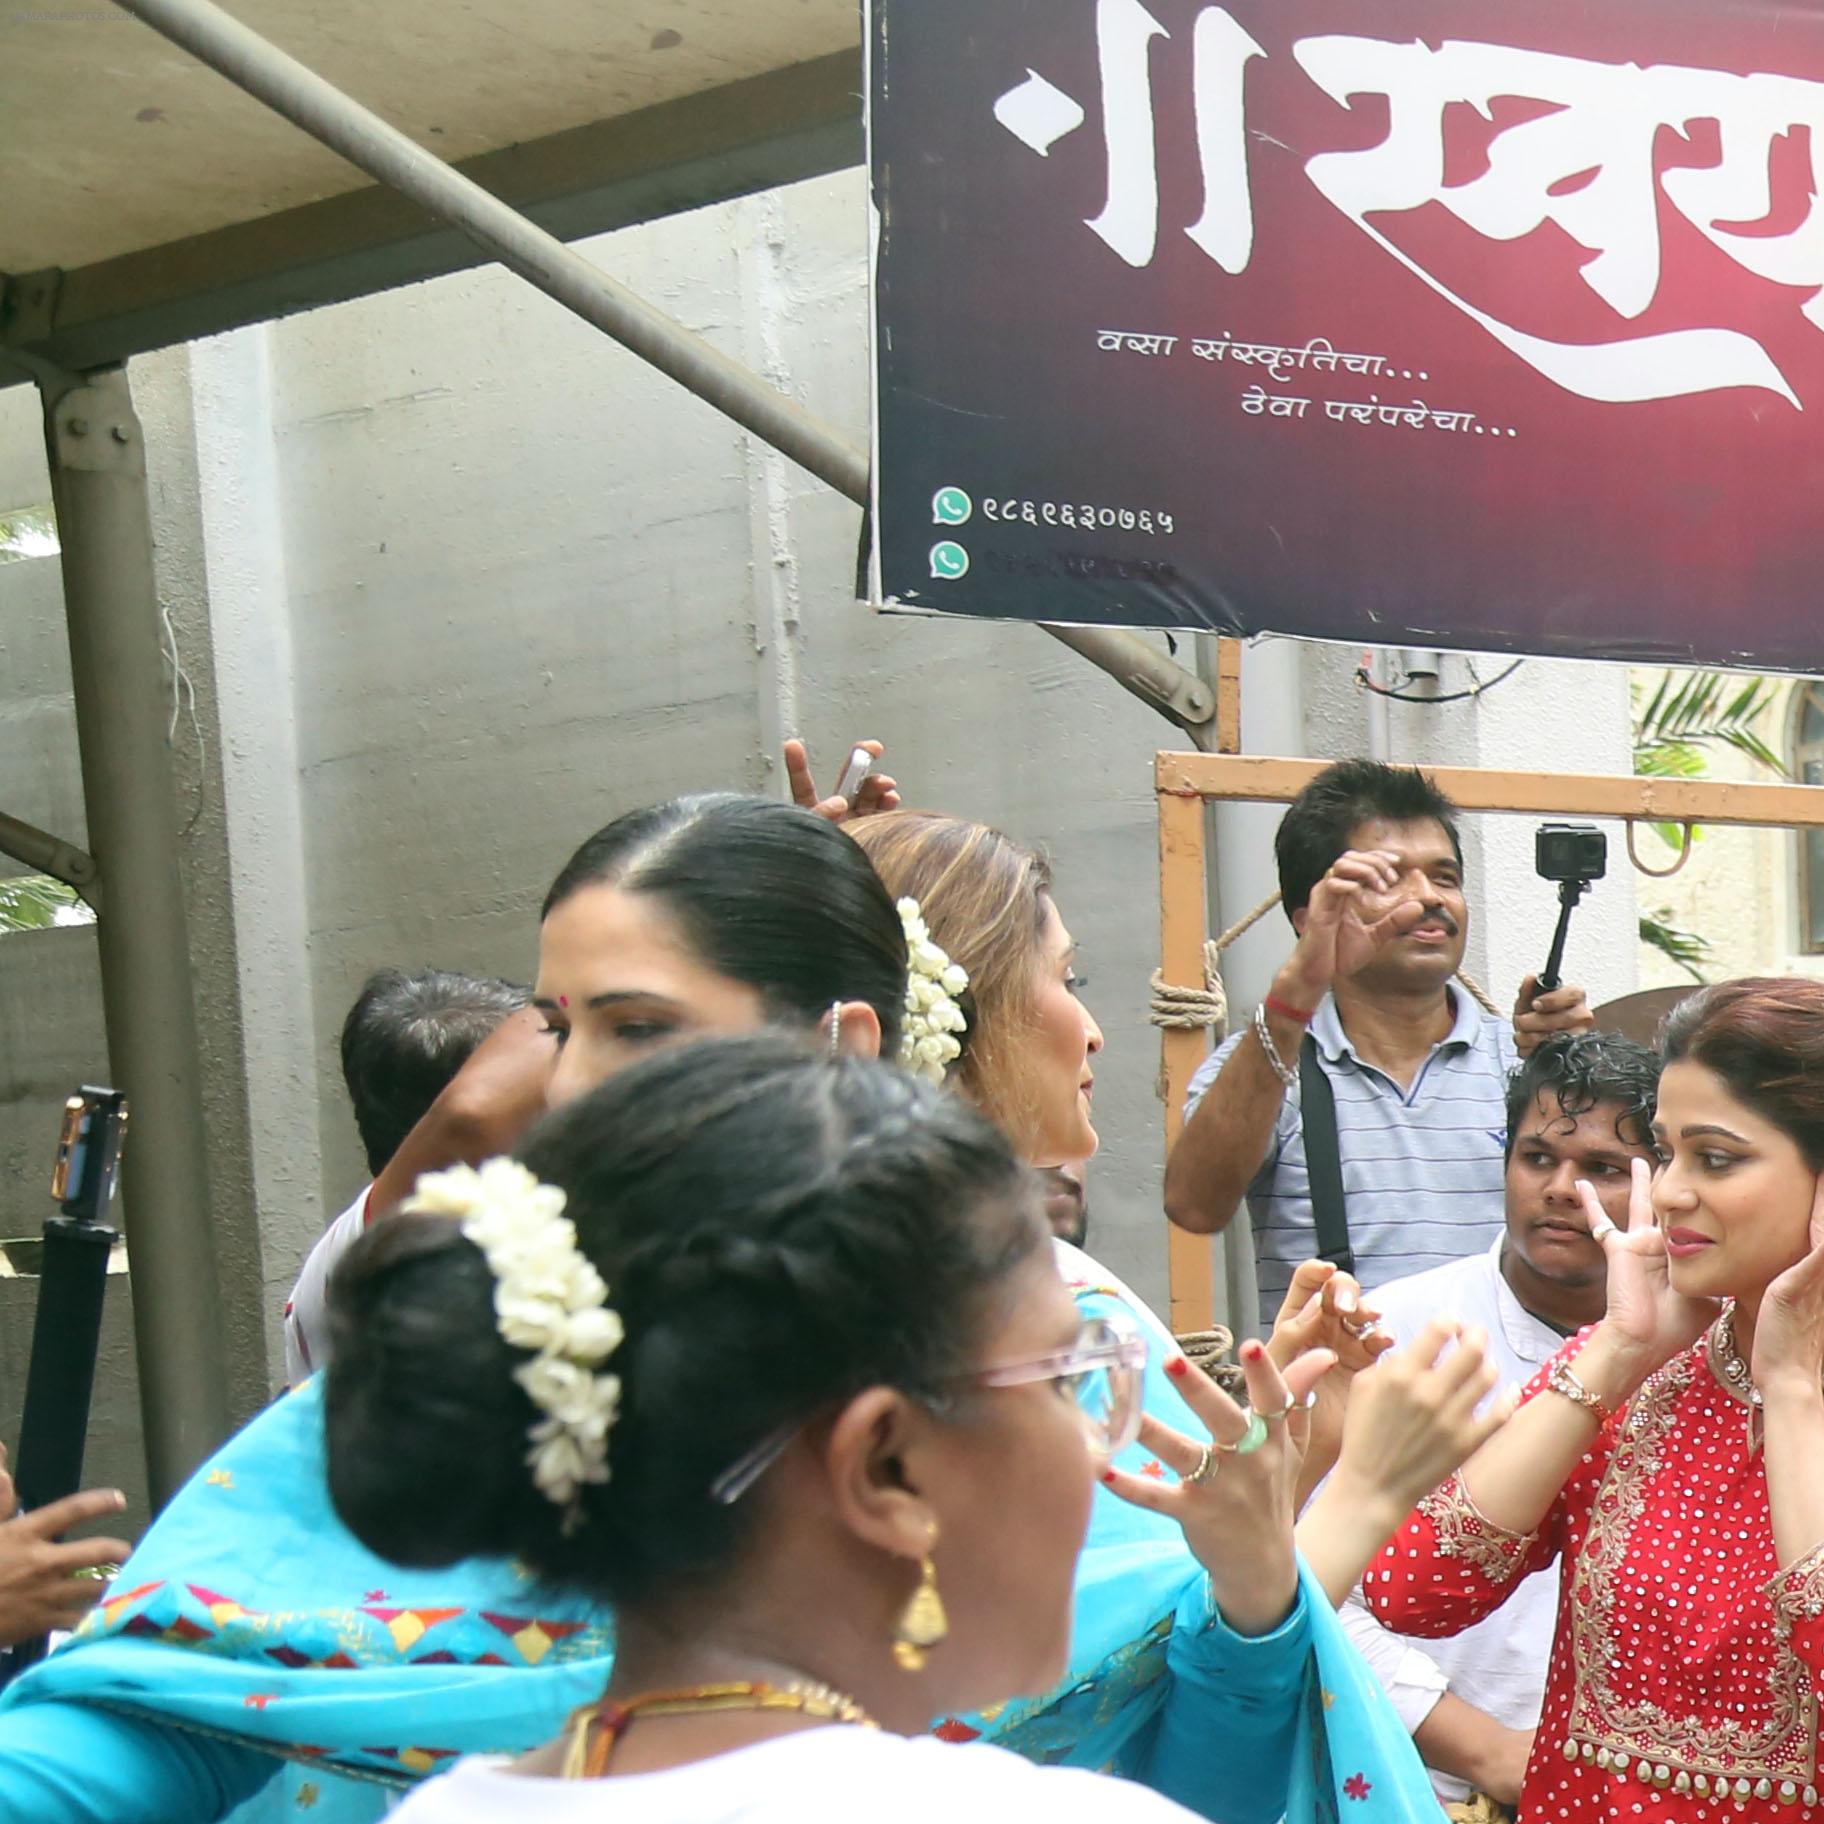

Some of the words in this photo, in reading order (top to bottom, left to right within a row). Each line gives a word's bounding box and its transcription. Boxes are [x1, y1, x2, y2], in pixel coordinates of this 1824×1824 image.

[1097, 329, 1178, 357] वसा
[1241, 384, 1312, 418] ठेवा
[982, 497, 1175, 535] ९८६९६३०७६५
